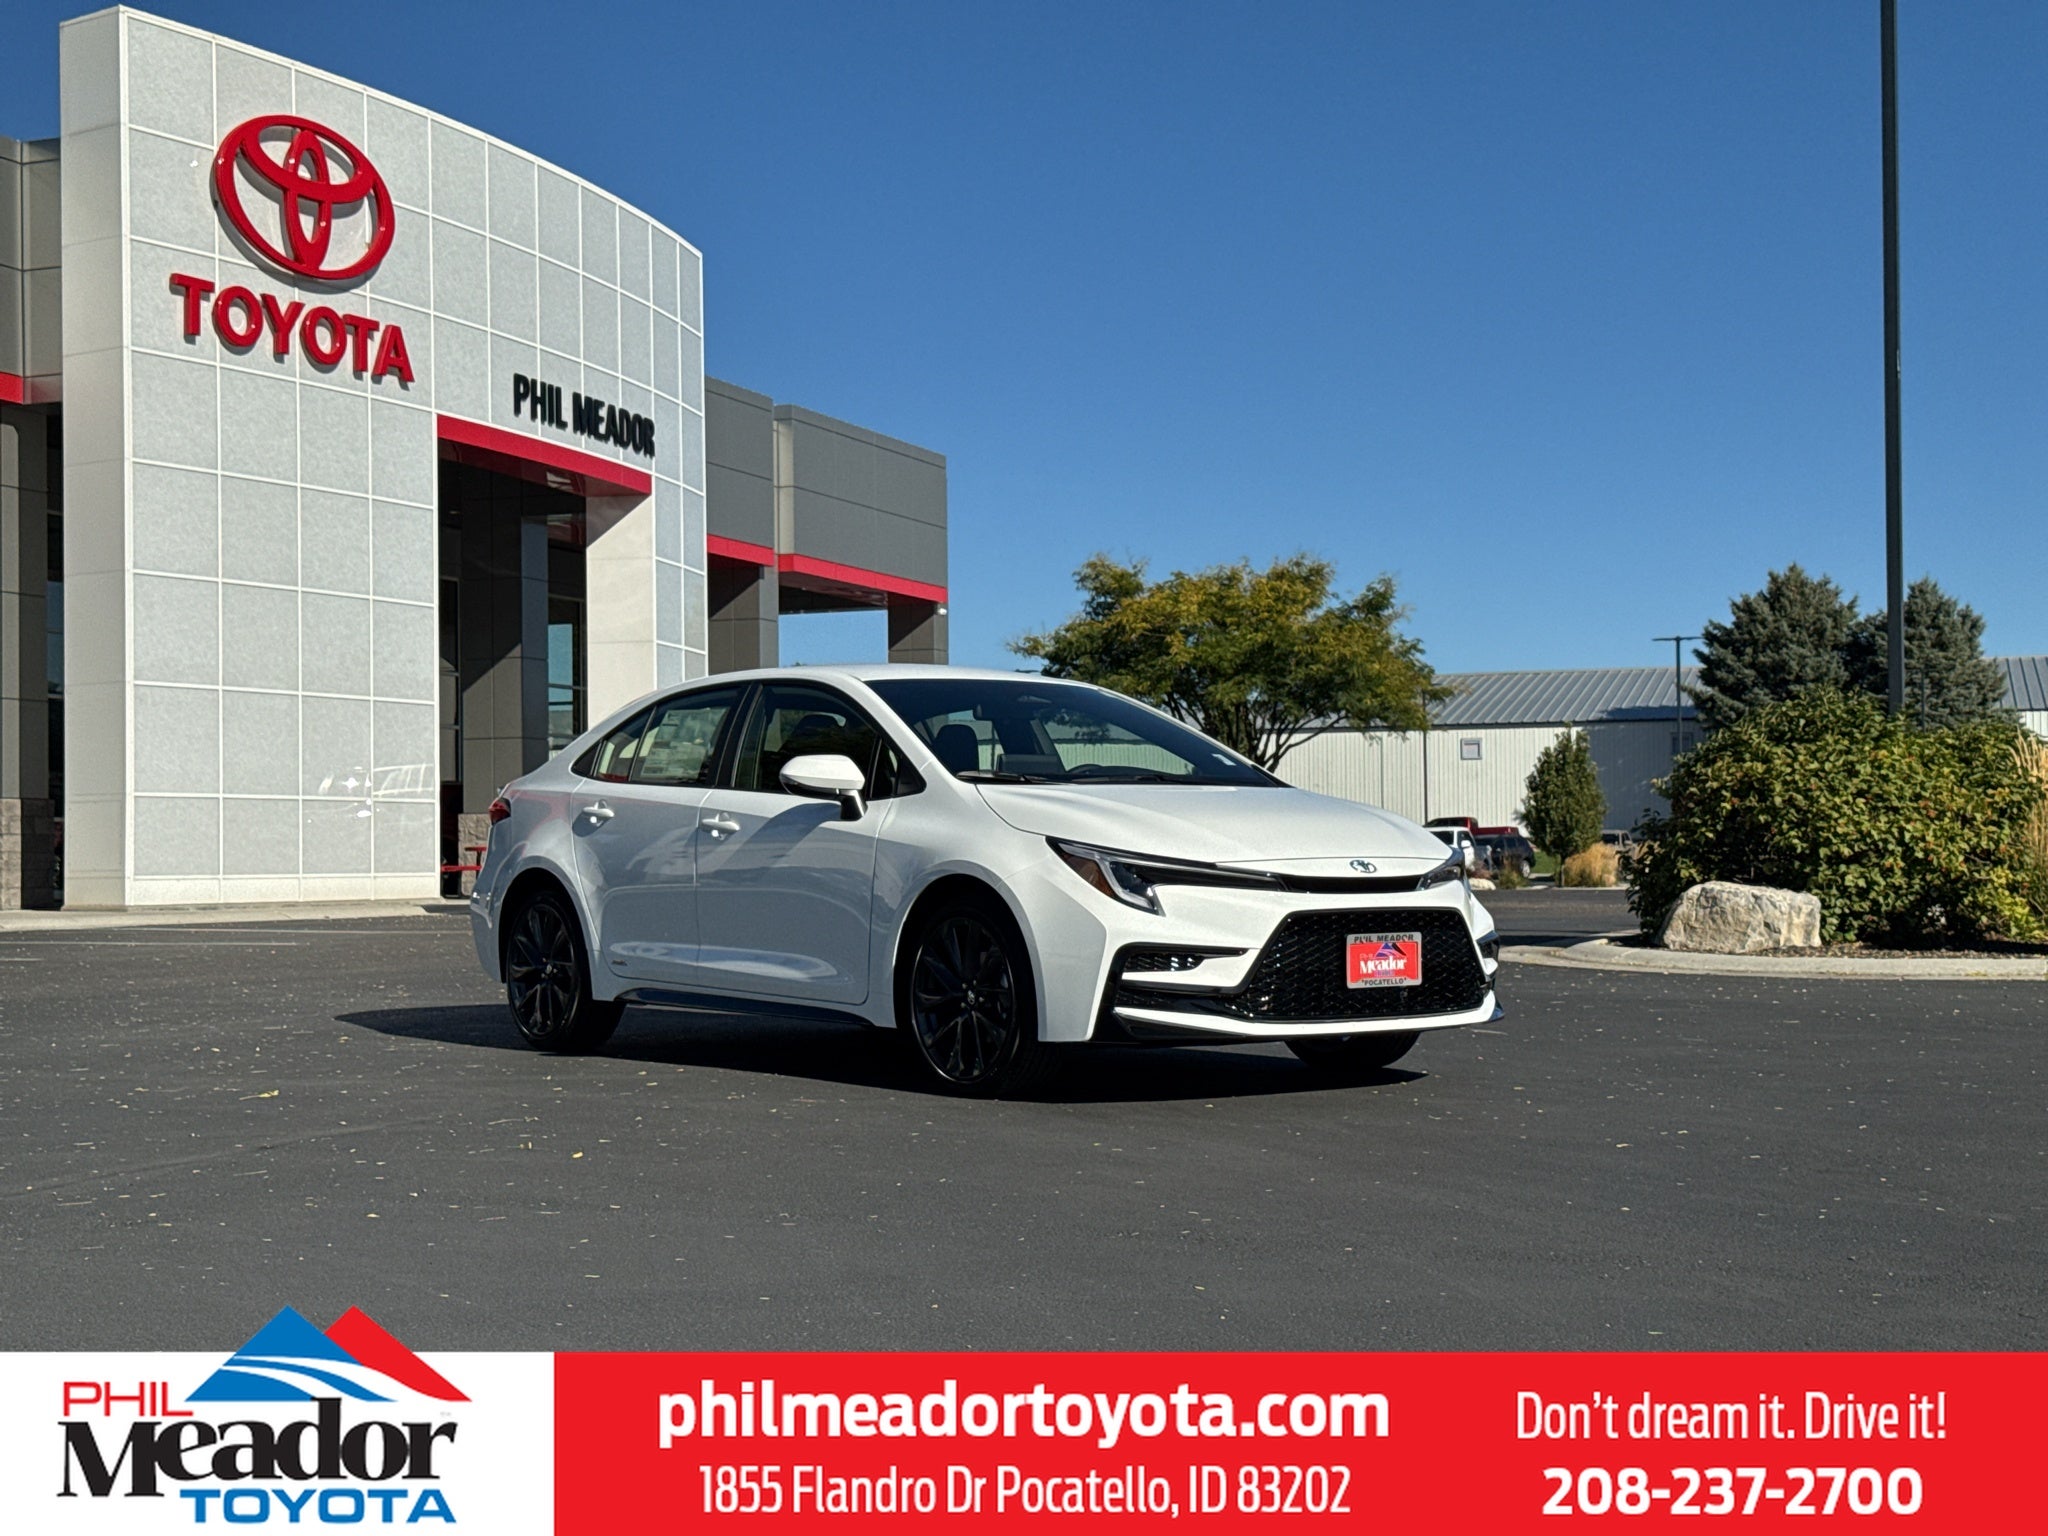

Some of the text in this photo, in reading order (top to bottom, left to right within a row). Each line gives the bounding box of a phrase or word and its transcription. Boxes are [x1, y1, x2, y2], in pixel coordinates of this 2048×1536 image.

[169, 273, 414, 383] TOYOTA
[513, 373, 655, 459] PHIL MEADOR
[1377, 934, 1414, 942] MEADOR
[1360, 955, 1407, 974] Meador
